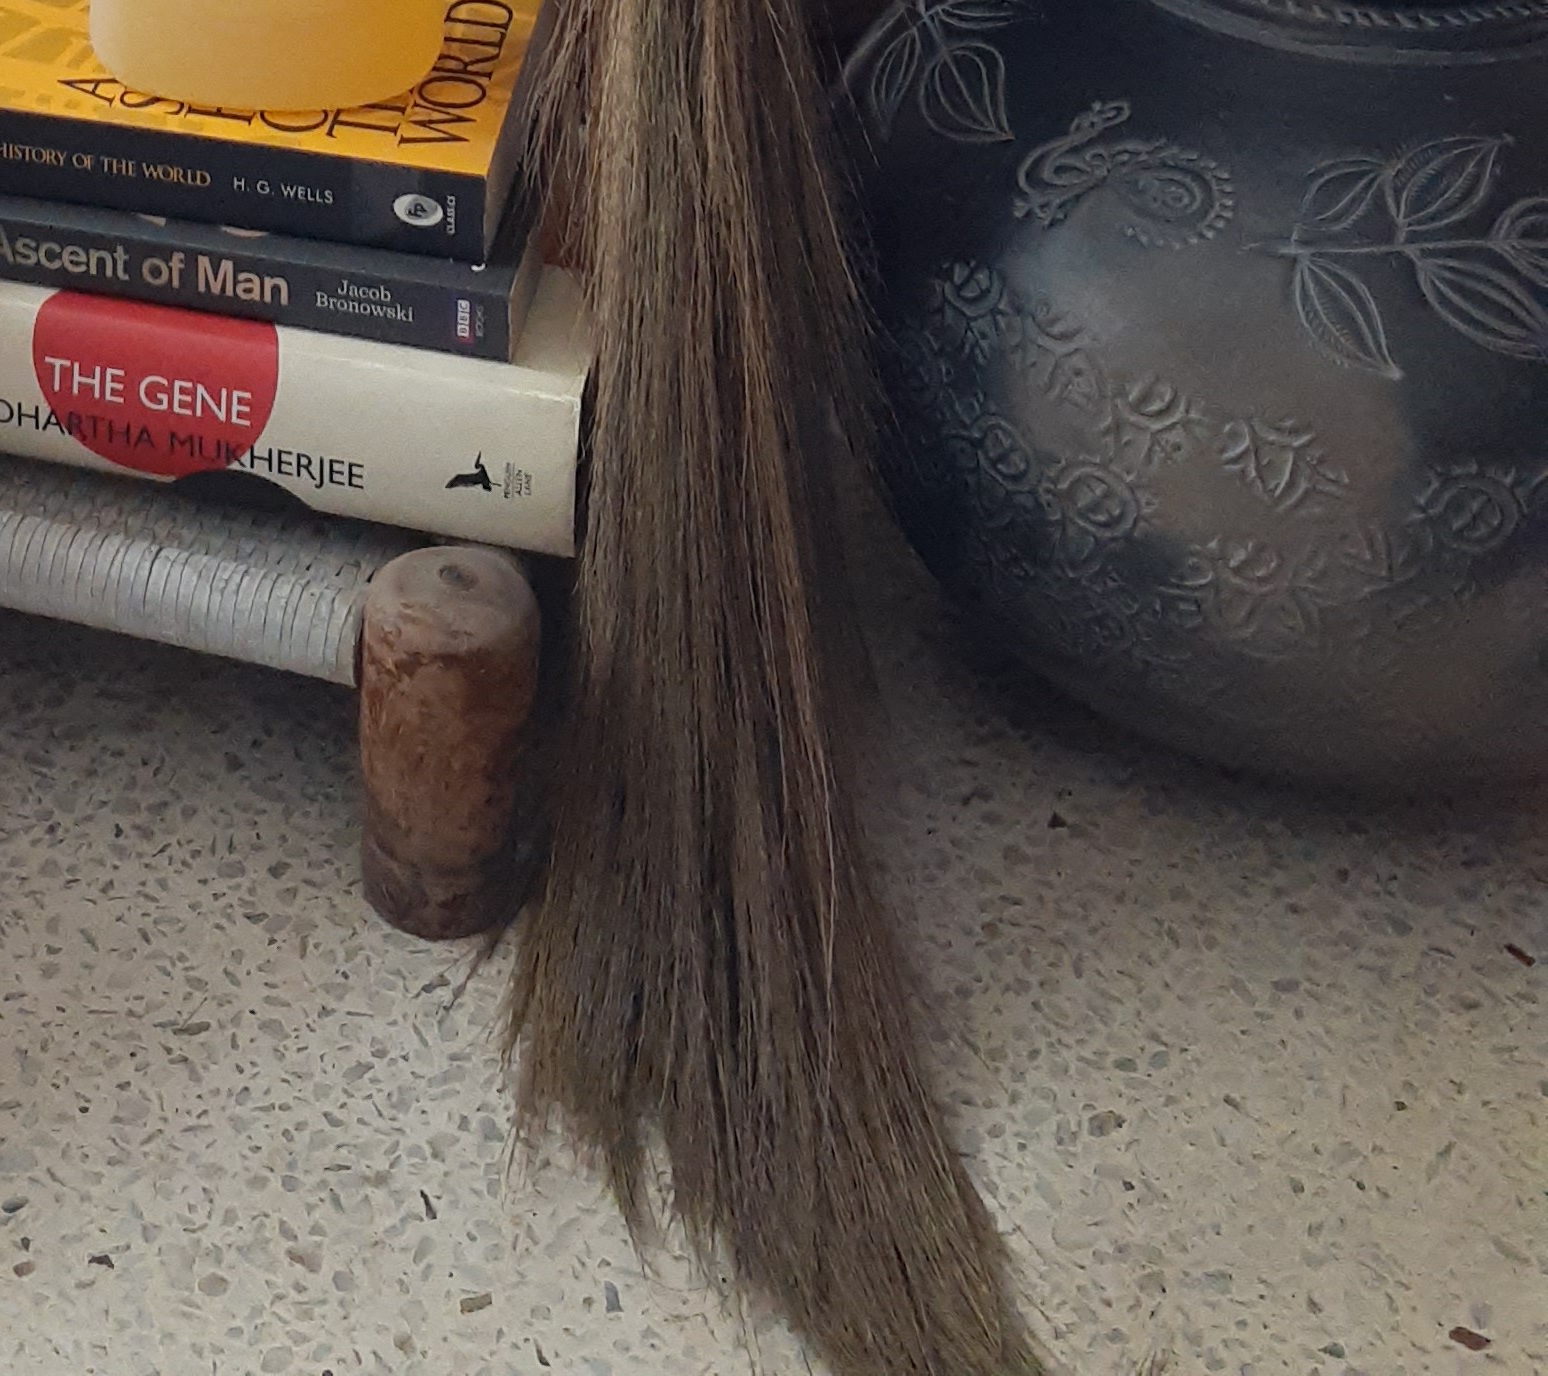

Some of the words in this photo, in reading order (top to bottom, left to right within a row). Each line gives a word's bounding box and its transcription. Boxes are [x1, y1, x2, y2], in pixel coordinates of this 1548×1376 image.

[72, 152, 95, 170] OF
[100, 155, 137, 176] THE
[142, 162, 212, 187] WORLD
[233, 176, 251, 193] H.
[256, 179, 275, 197] G.
[281, 182, 335, 205] WELLS
[142, 251, 186, 288] of
[196, 254, 290, 307] Man
[337, 279, 392, 303] Jacob
[315, 291, 414, 324] Bronowski
[456, 298, 471, 339] BBC
[43, 355, 126, 404] THE
[138, 375, 253, 427] GENE
[168, 430, 366, 490] MUKHERJEE
